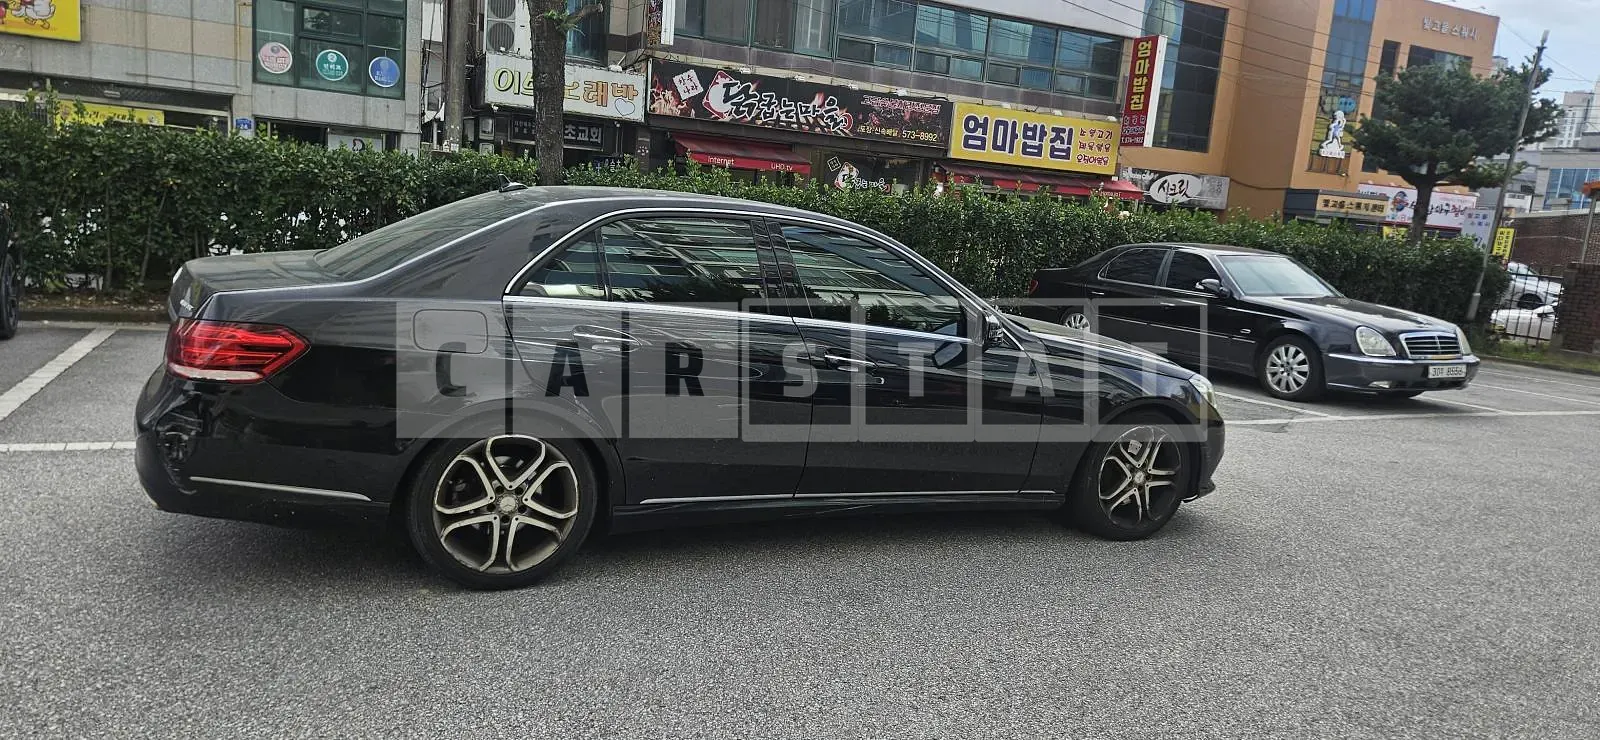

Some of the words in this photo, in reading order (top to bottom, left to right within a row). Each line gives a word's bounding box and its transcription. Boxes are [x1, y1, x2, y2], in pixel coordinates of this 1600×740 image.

[1129, 41, 1152, 111] 엄마밥집
[961, 113, 1074, 161] 엄마밥집
[1157, 179, 1192, 199] 시크릿
